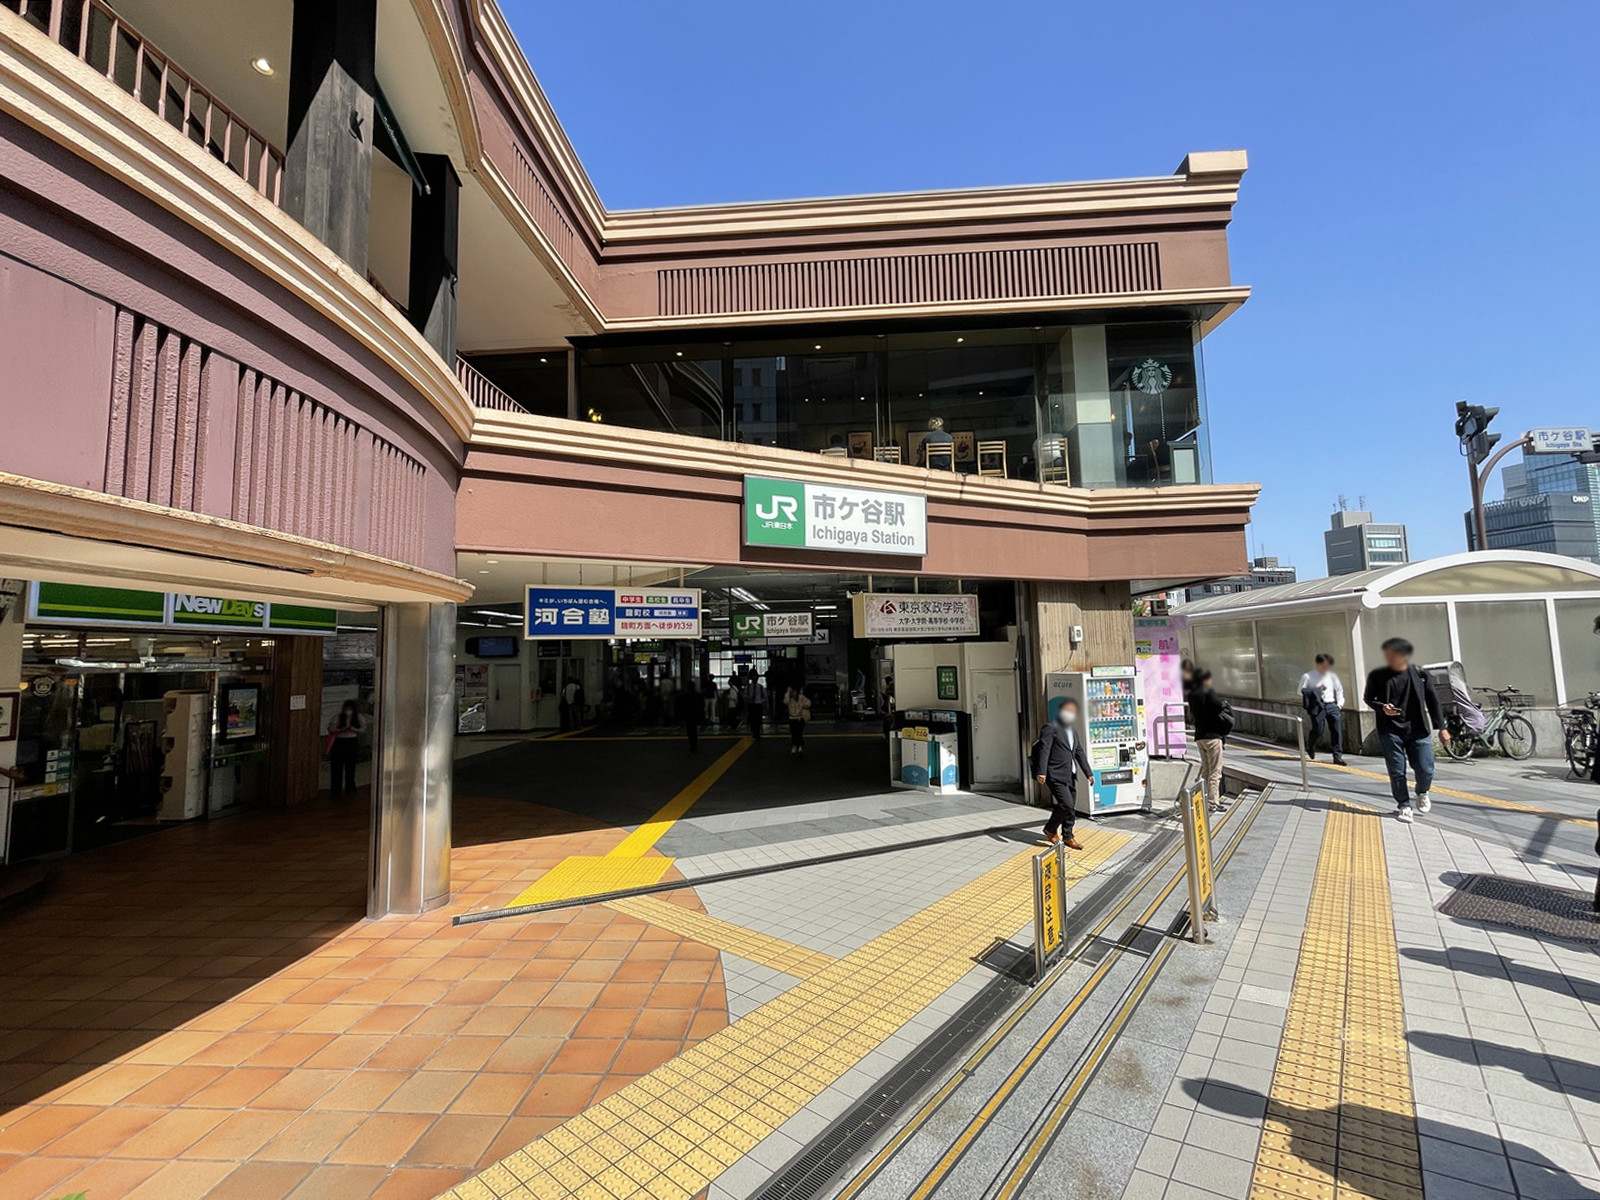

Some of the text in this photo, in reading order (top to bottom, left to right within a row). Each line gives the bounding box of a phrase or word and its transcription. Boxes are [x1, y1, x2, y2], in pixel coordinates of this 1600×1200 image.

[1572, 495, 1590, 503] DNP
[755, 495, 798, 522] JR
[812, 493, 905, 526] 市ケ谷駅
[761, 521, 793, 530] JR東日本
[812, 525, 914, 546] Ichigaya Station
[175, 594, 264, 618] NewDays
[899, 600, 965, 614] 東京家政学院
[534, 607, 610, 625] 河合塾
[736, 616, 761, 630] JR
[767, 614, 809, 626] 市ケ谷駅
